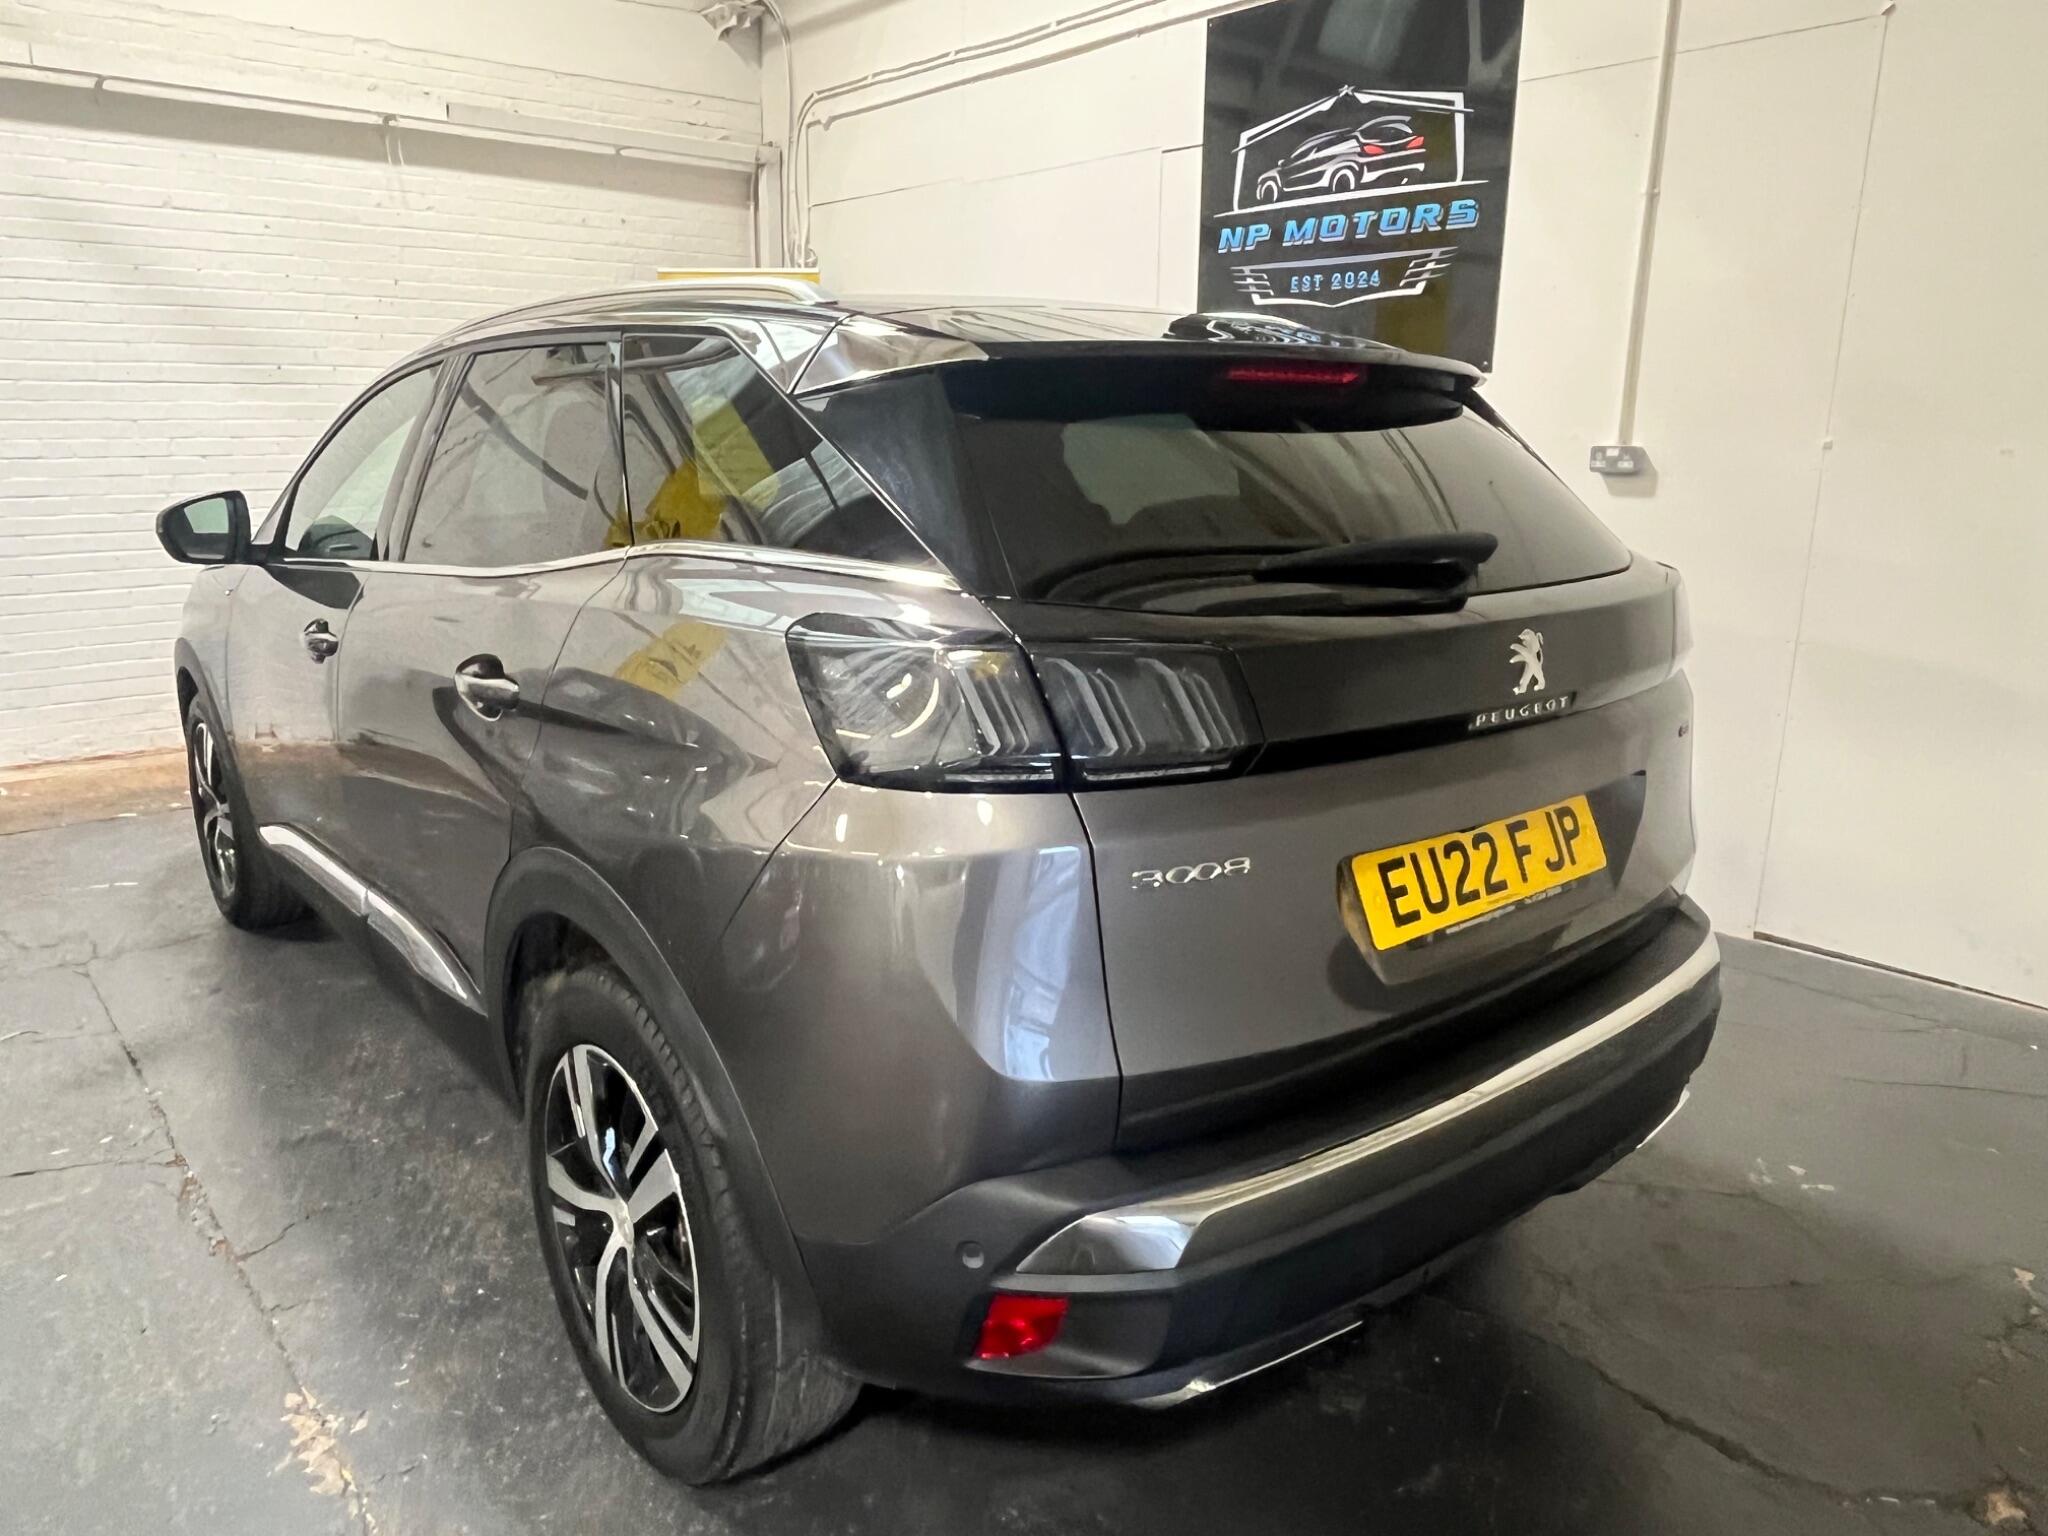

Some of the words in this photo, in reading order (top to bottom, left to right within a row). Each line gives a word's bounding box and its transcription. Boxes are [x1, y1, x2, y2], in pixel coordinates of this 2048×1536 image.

[1218, 223, 1271, 254] NP
[1282, 199, 1480, 247] MOTORS
[1290, 274, 1323, 293] EST
[1331, 269, 1380, 291] 2024
[1473, 695, 1569, 728] PEUGEOT
[1132, 856, 1251, 889] 3008
[1378, 831, 1508, 928] EU22
[1505, 805, 1581, 883] FJP
